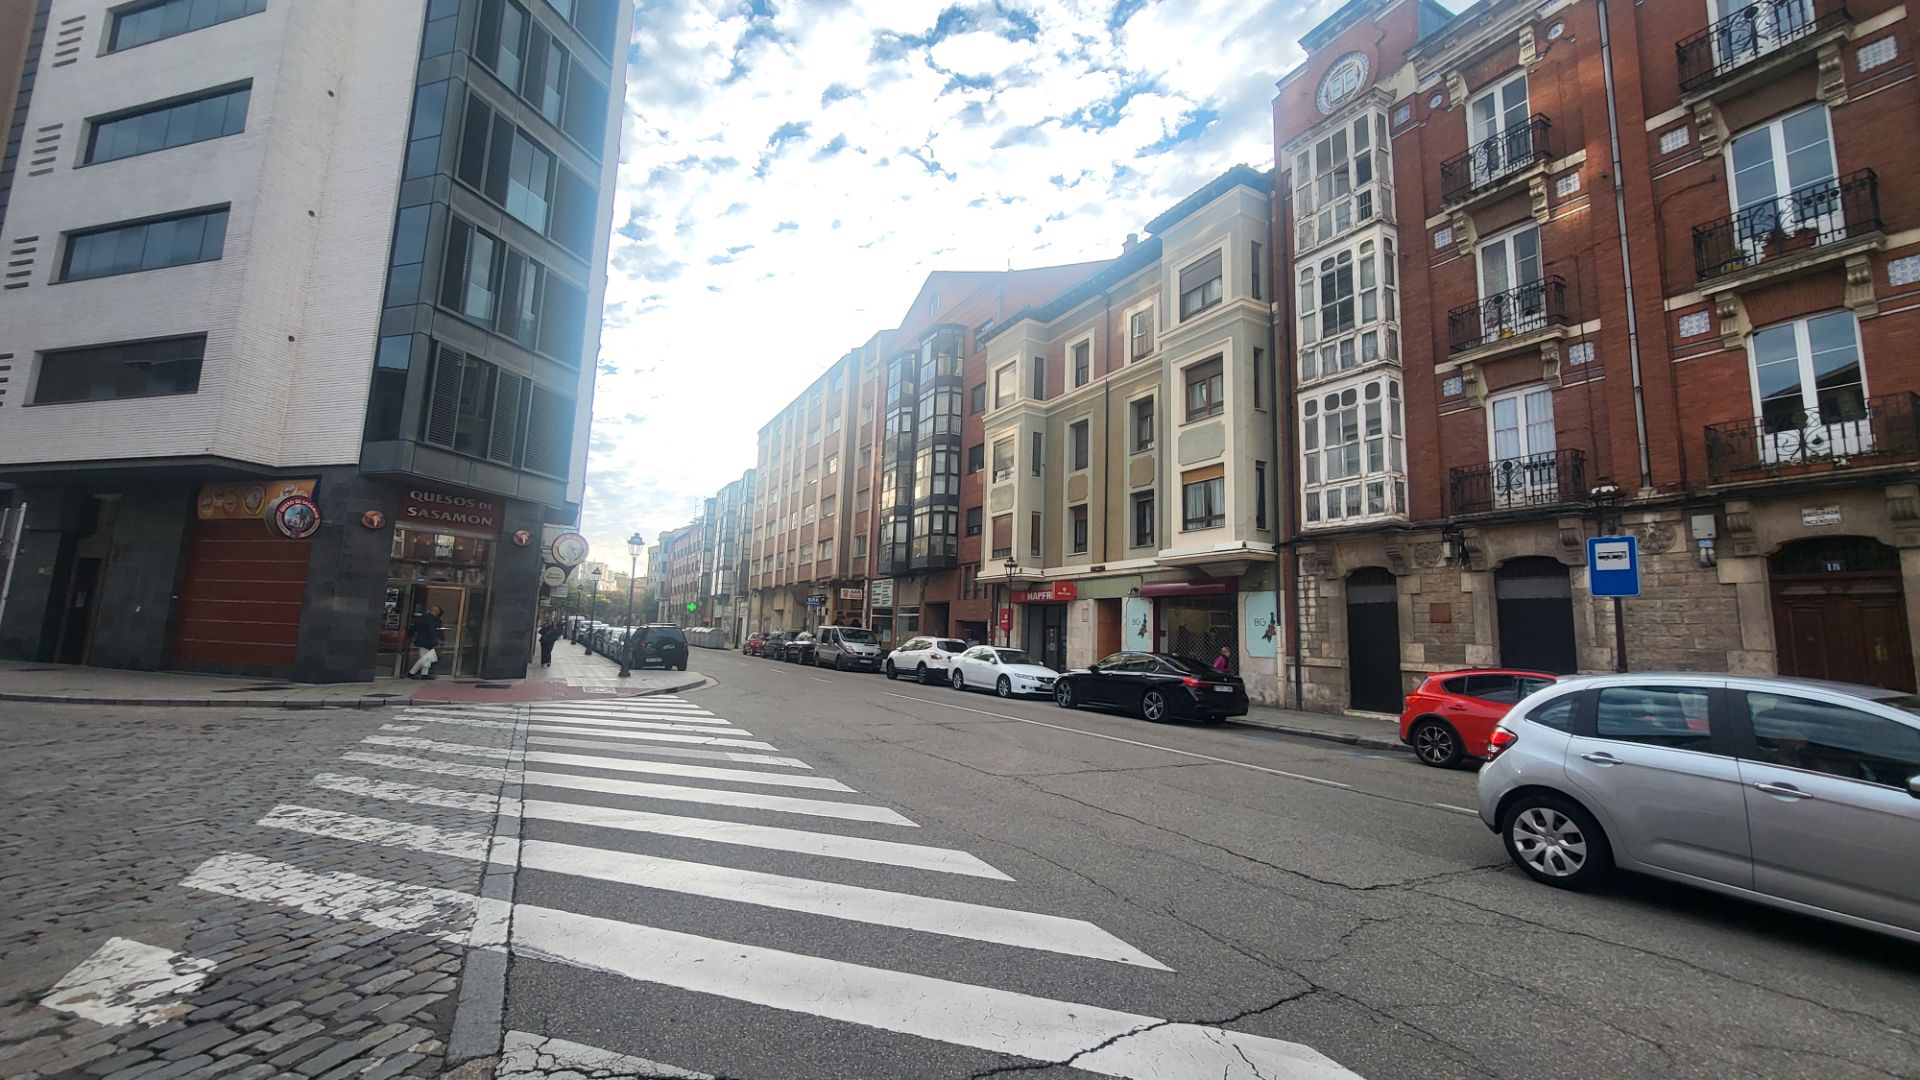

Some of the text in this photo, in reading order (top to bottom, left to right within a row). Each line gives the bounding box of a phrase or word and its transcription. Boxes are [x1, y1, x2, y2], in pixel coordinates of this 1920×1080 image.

[409, 489, 475, 508] QUESOS
[407, 506, 493, 526] SASAMON
[1826, 563, 1841, 572] 18
[1026, 590, 1054, 601] MAPFR
[1132, 618, 1141, 626] BG
[1254, 617, 1267, 627] BG
